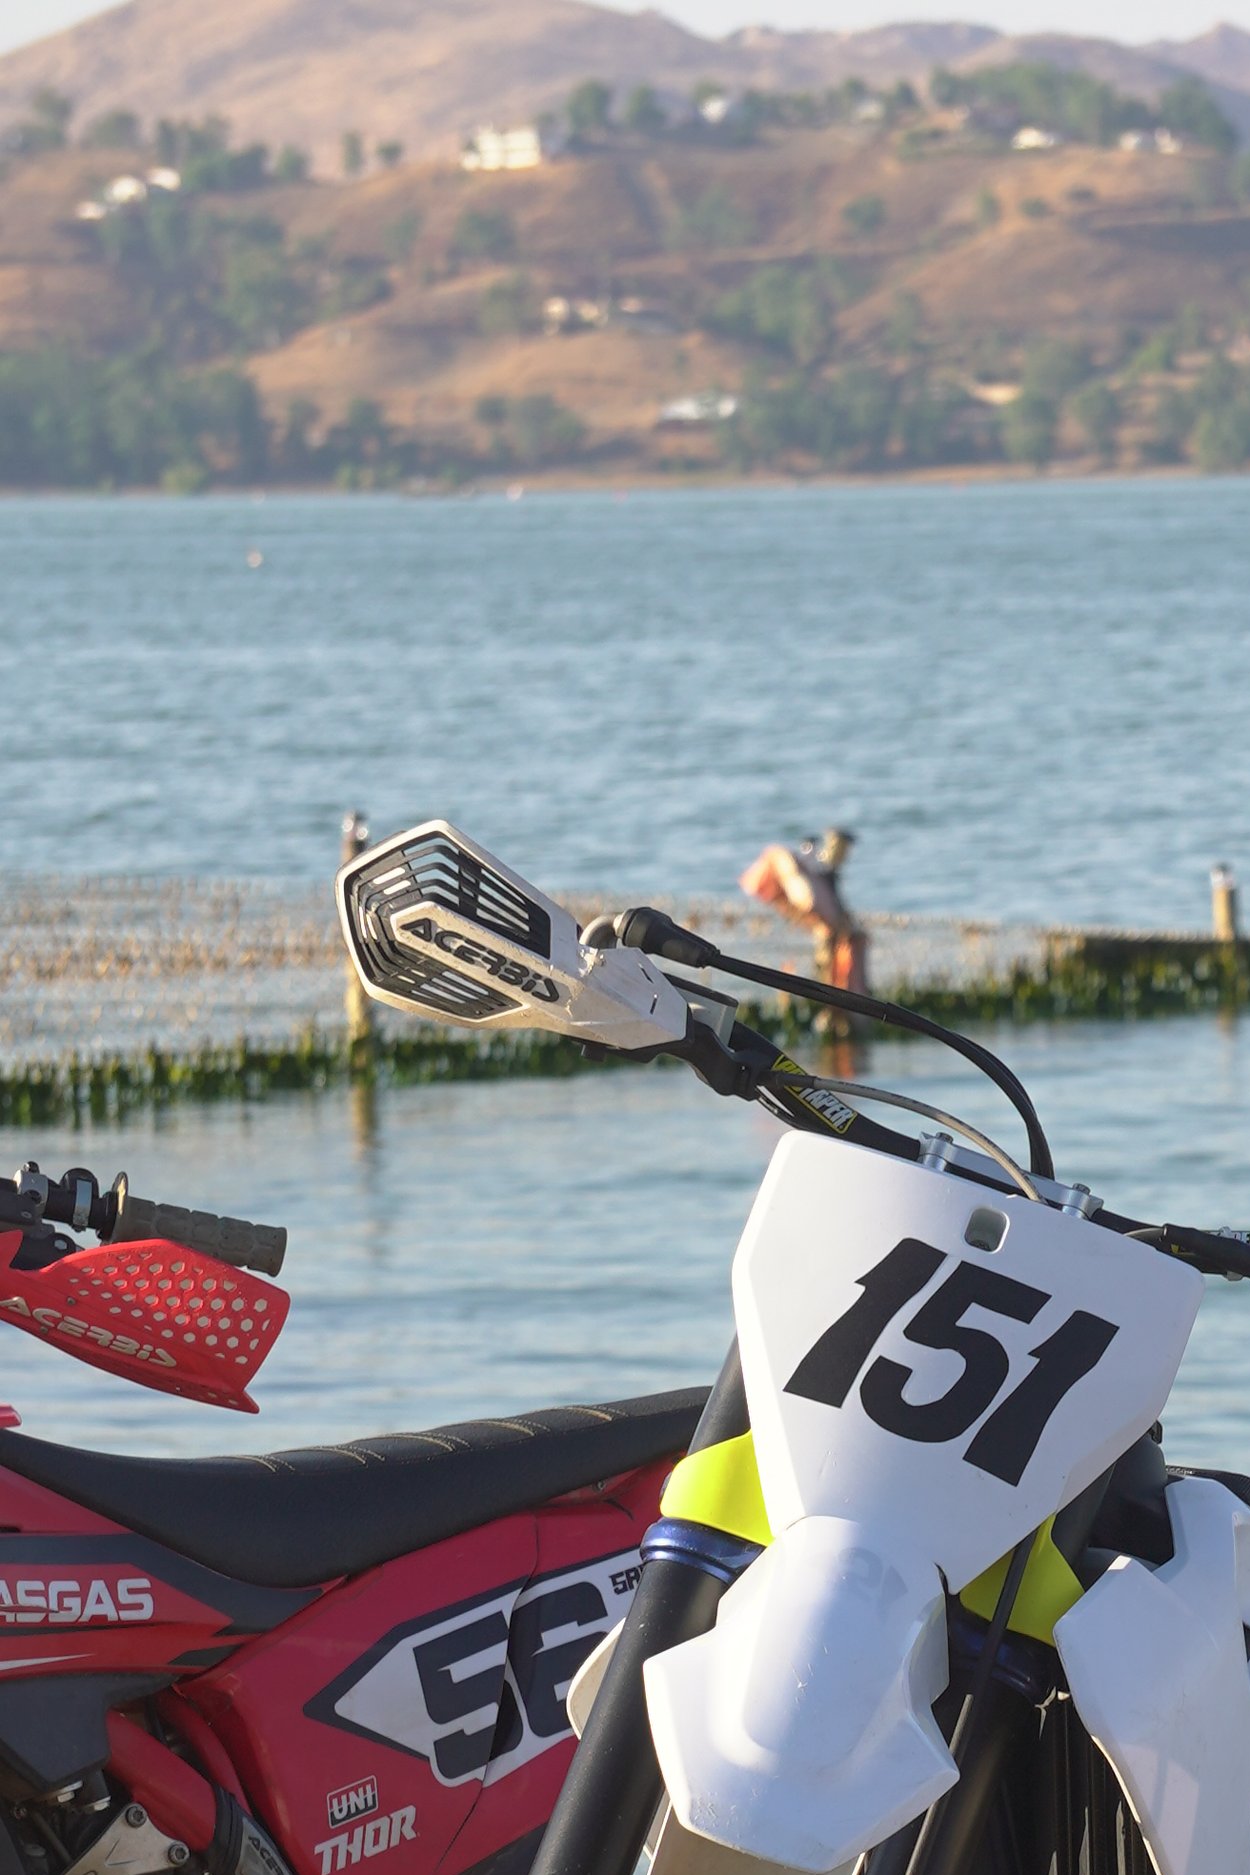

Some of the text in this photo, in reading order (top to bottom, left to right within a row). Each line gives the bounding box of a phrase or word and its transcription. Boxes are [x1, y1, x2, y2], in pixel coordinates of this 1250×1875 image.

[400, 918, 559, 1002] ACERBIS
[0, 1296, 177, 1367] ACERBIS
[783, 1237, 1119, 1487] 151
[608, 1563, 645, 1595] SR
[413, 1581, 608, 1779] 56
[332, 1784, 373, 1820] UNI
